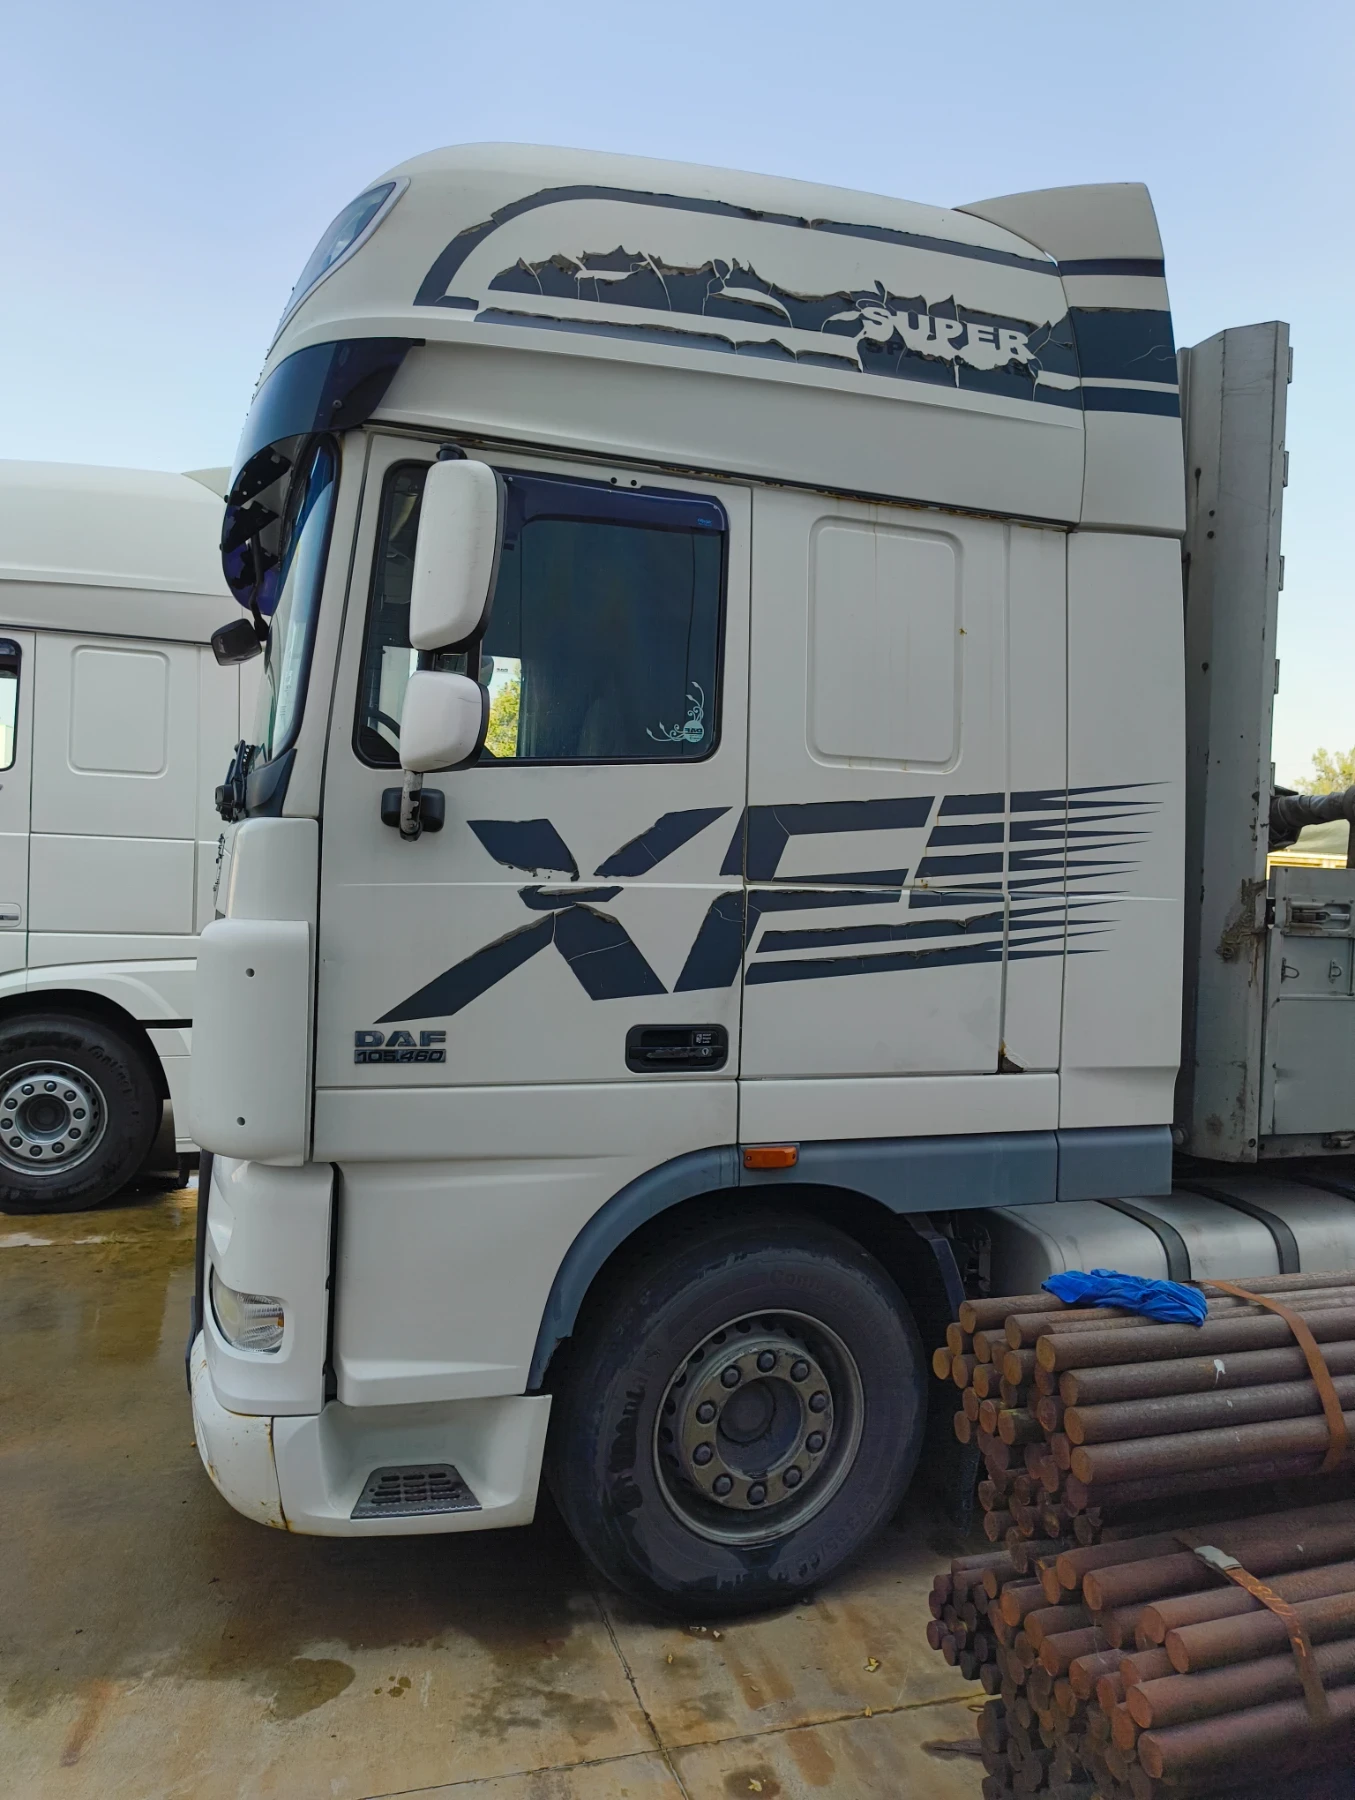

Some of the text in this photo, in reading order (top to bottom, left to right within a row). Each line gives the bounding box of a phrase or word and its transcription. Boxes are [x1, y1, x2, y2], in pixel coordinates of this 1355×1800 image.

[862, 306, 1036, 364] SUPER
[355, 1030, 446, 1048] DAF
[356, 1050, 444, 1062] 105.460
